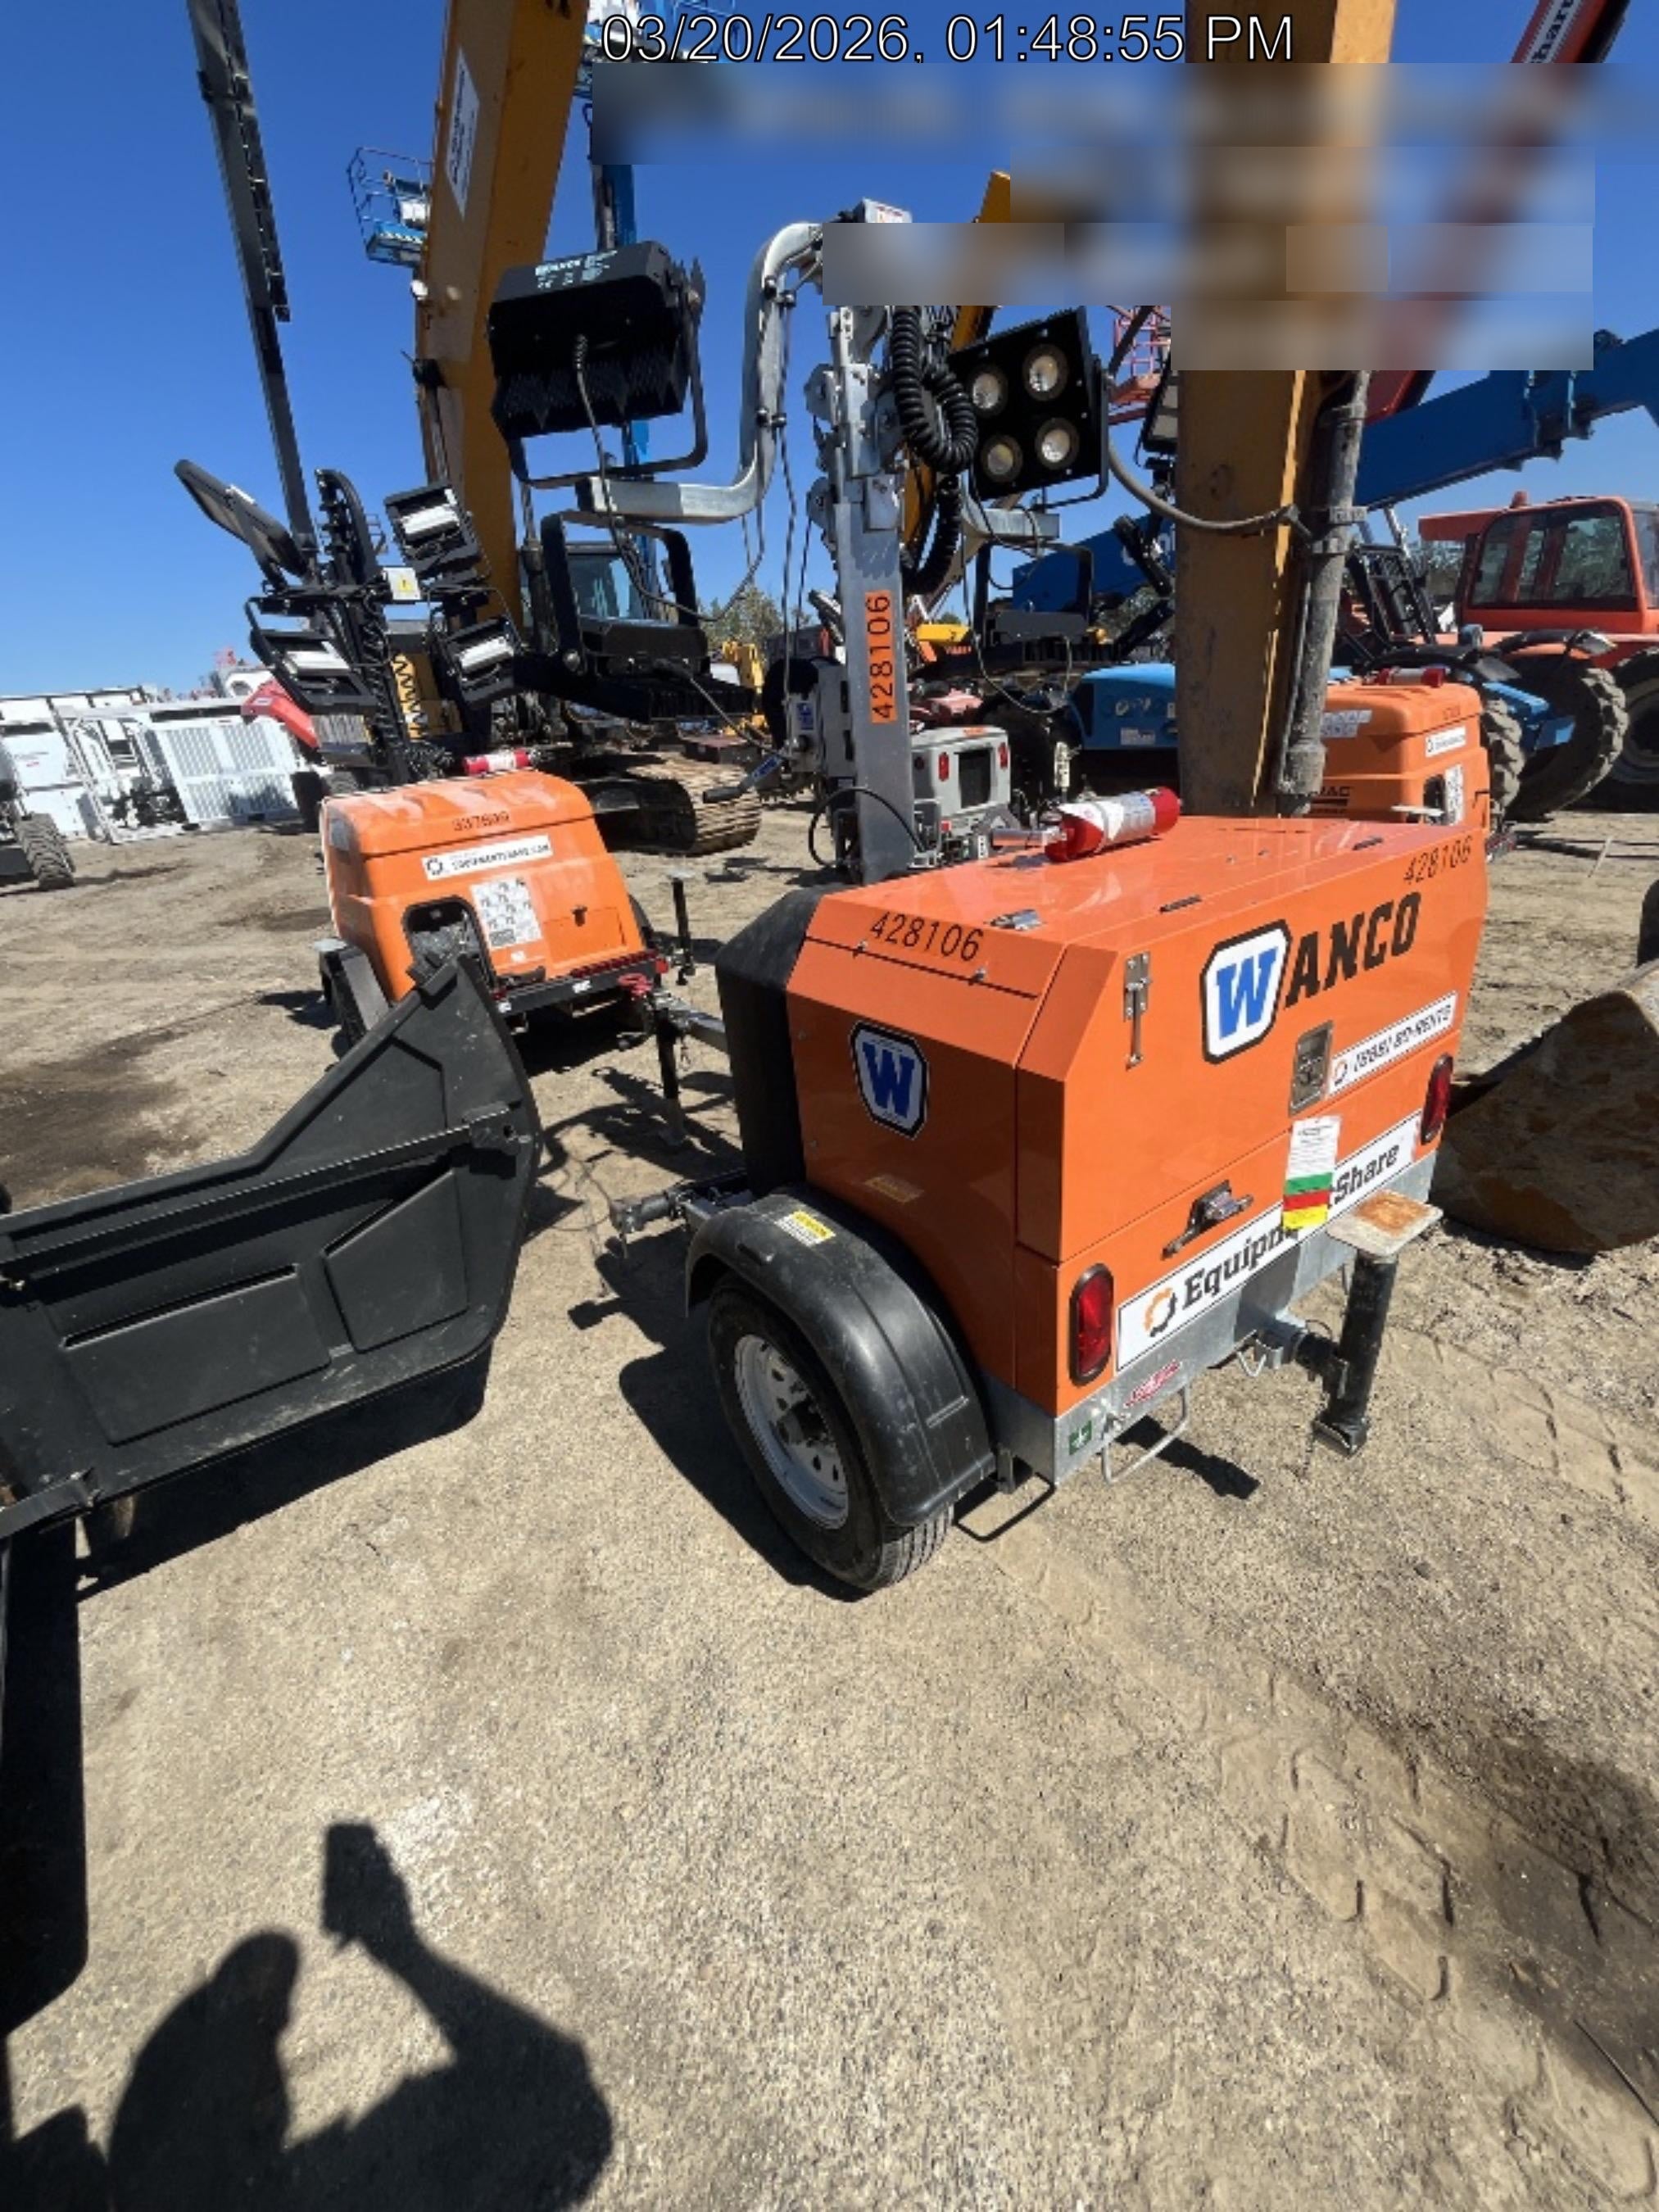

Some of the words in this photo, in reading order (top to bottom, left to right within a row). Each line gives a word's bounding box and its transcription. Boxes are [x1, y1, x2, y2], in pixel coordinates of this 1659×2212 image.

[865, 596, 893, 718] 428106
[1403, 835, 1472, 885] 428106
[870, 911, 984, 962] 428106
[1213, 891, 1421, 1045] WANCO
[862, 1041, 915, 1119] W
